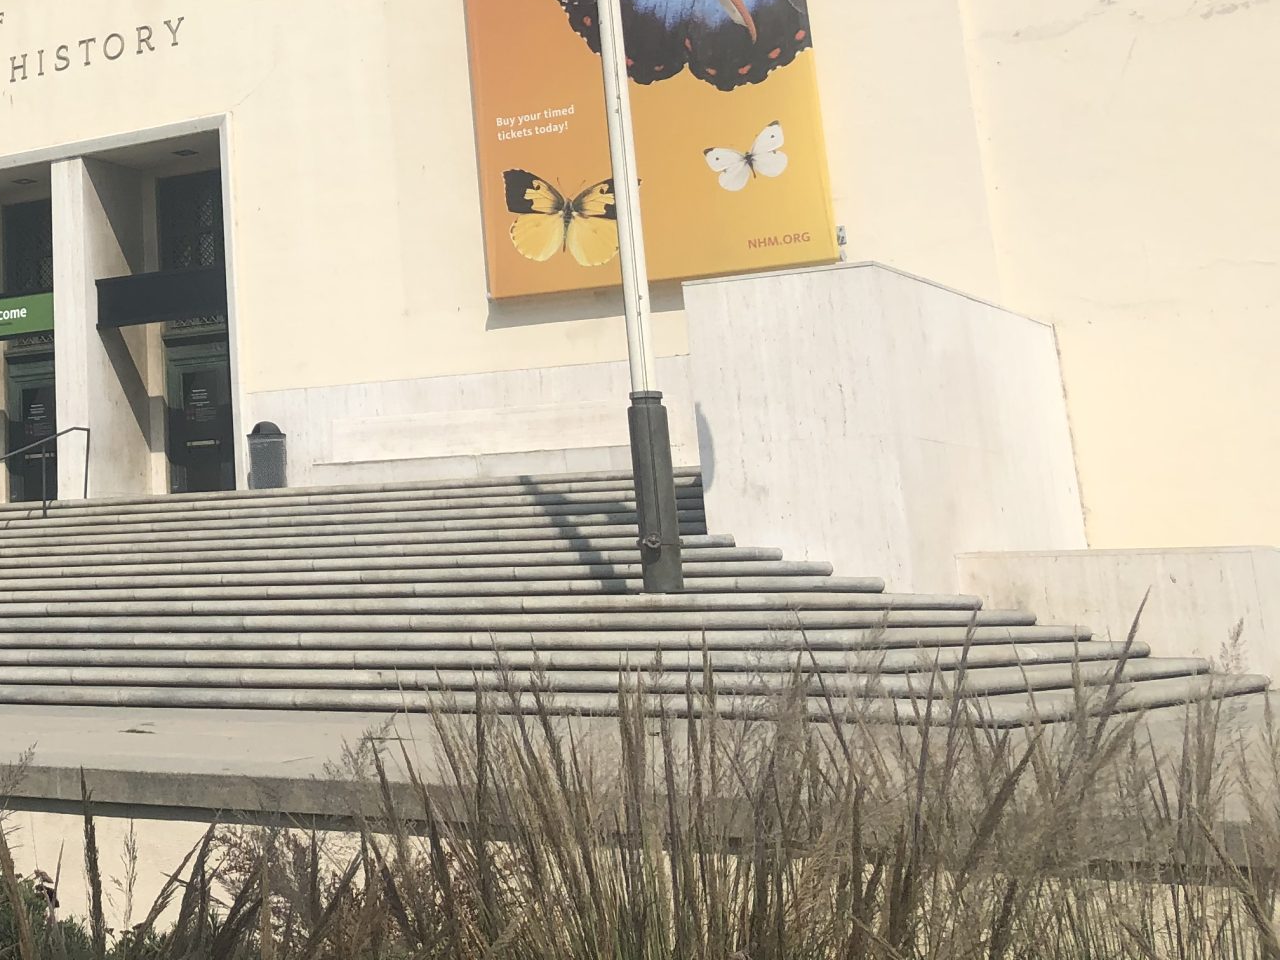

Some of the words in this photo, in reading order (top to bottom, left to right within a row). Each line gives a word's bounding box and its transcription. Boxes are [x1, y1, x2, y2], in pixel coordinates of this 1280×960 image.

[9, 16, 185, 83] HISTORY
[496, 117, 516, 127] Buy
[517, 112, 541, 125] your
[543, 104, 575, 118] timed
[497, 128, 533, 141] tickets
[534, 121, 568, 134] today!
[747, 231, 811, 249] NHM.ORG
